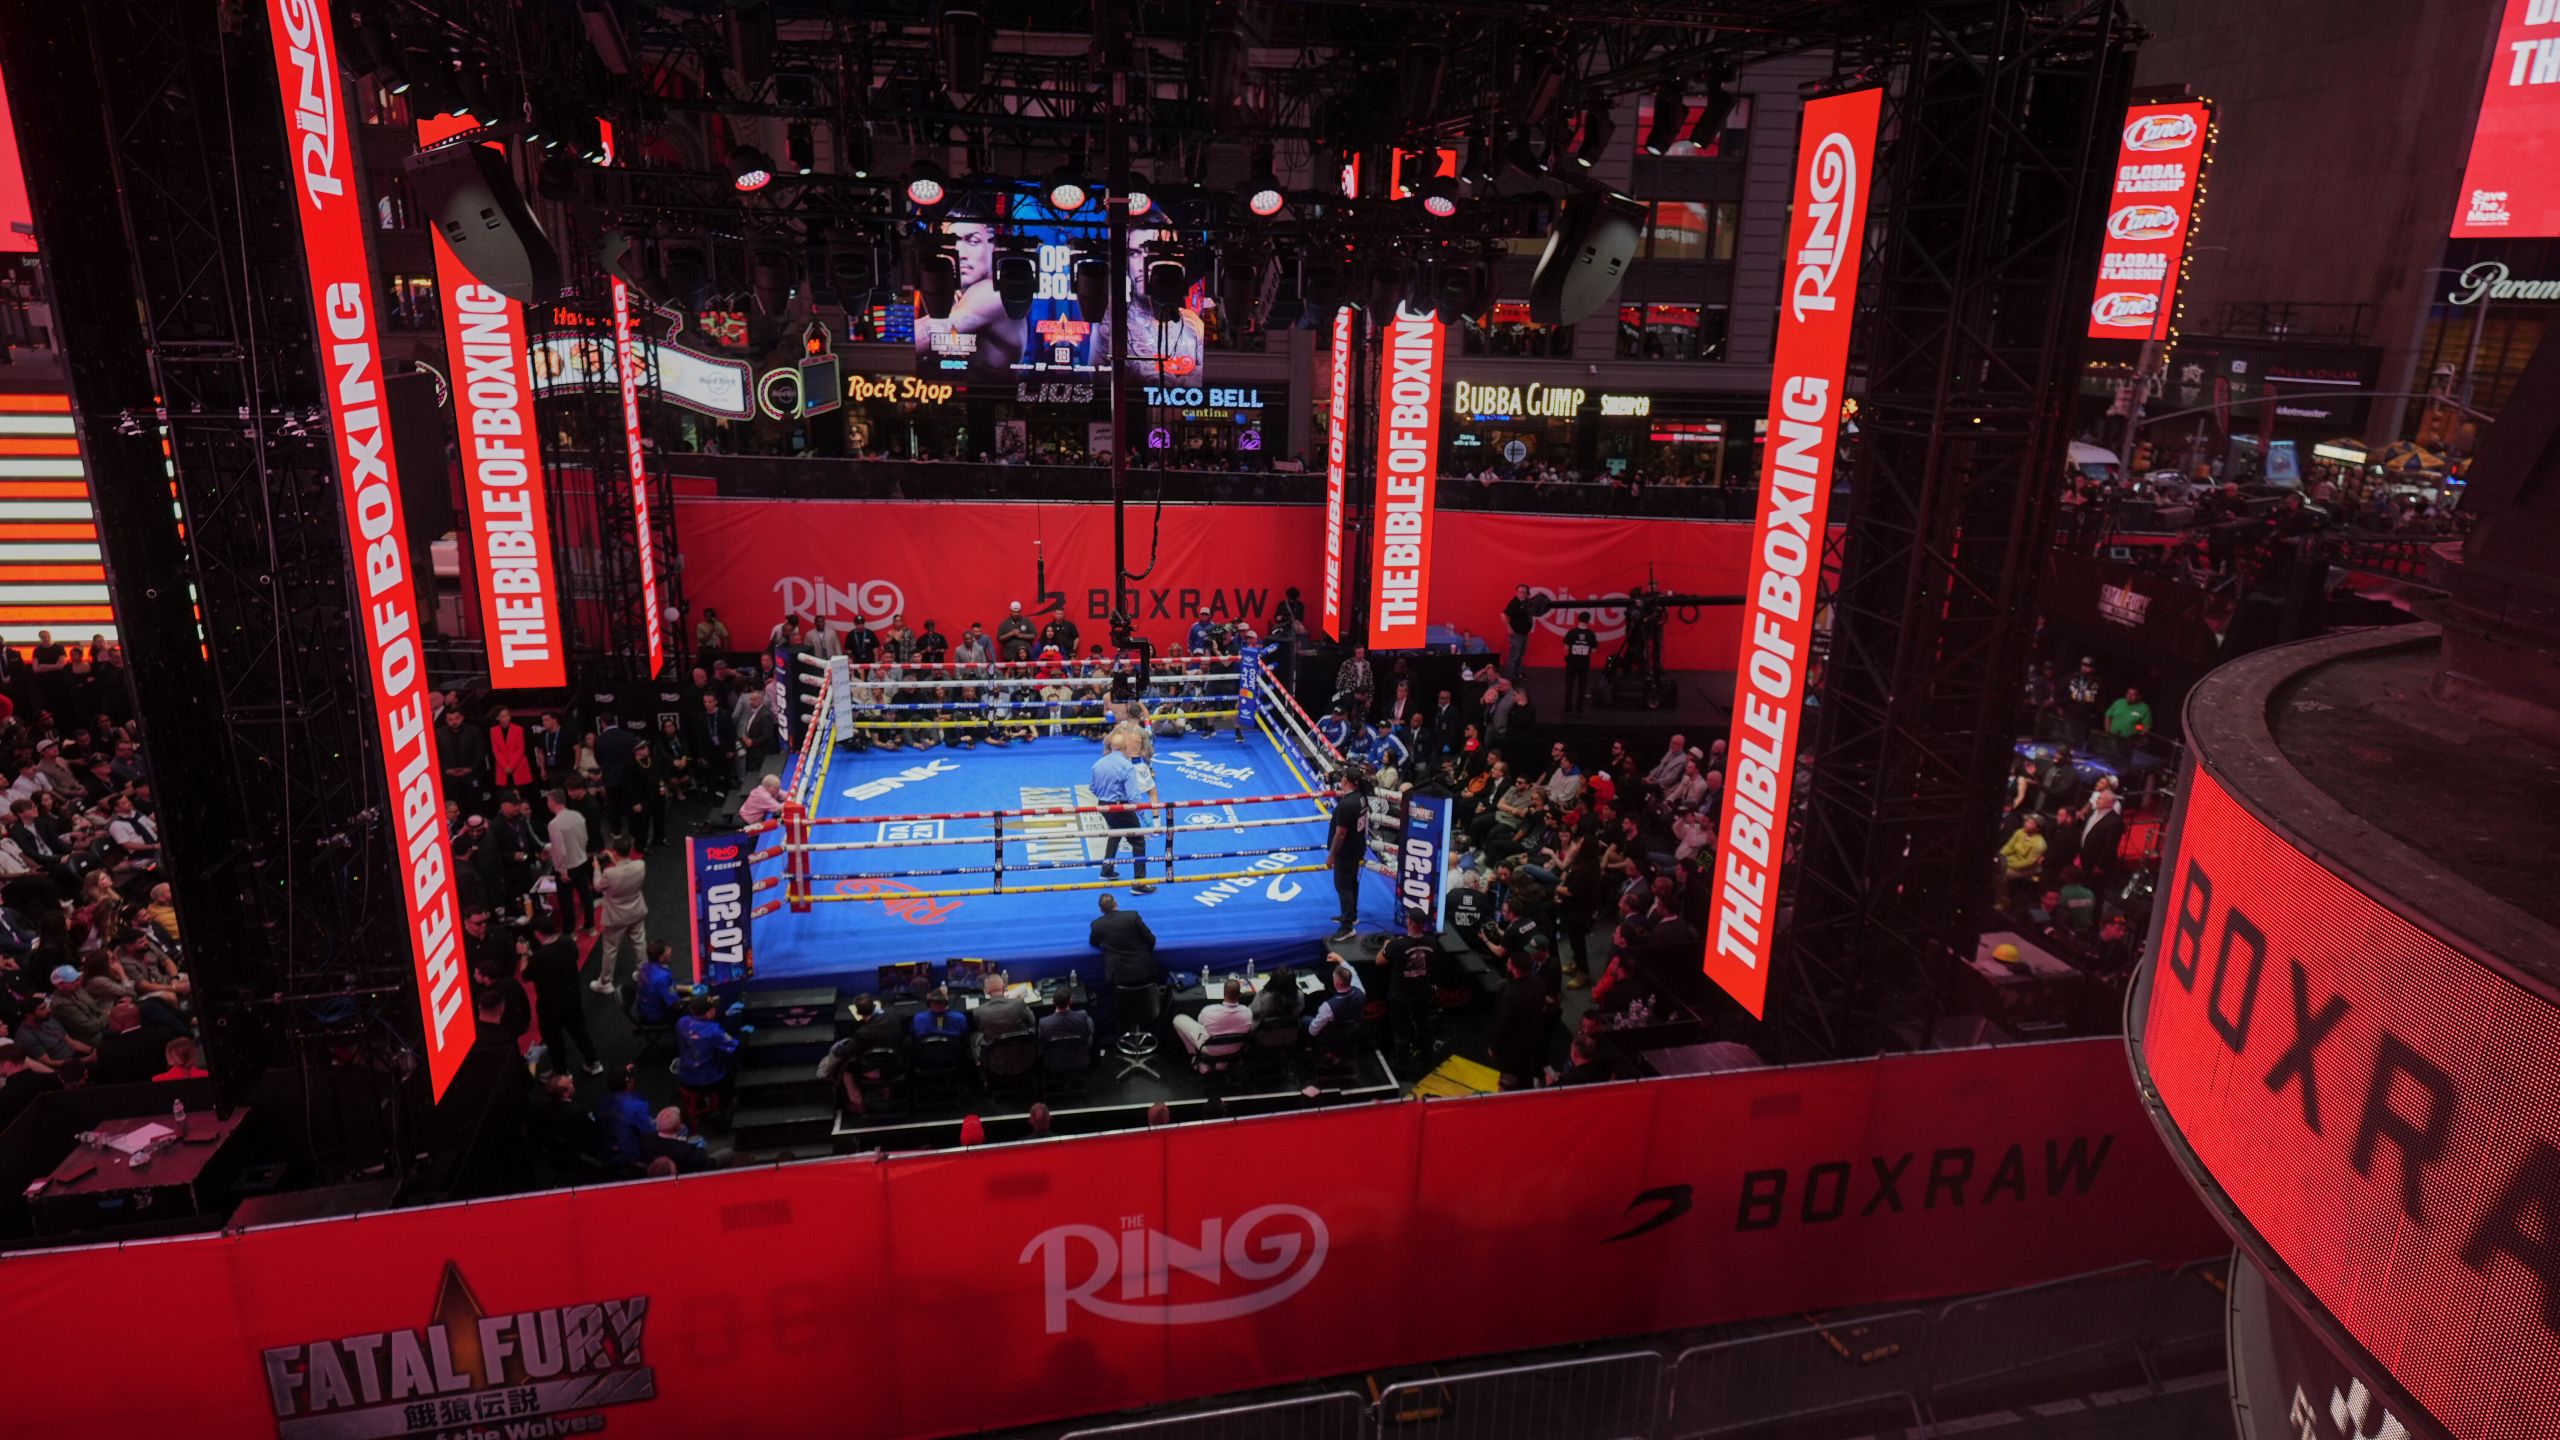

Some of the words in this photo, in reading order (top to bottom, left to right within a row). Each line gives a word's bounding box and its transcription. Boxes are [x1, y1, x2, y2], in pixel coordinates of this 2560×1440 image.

[280, 0, 343, 210] RING
[2116, 179, 2185, 193] FLAGSHIP
[2119, 164, 2185, 180] GLOBAL
[2471, 189, 2508, 202] Save
[1793, 133, 1856, 322] RING
[2467, 211, 2511, 222] Music
[2471, 201, 2498, 212] The
[2101, 267, 2166, 280] FLAGSHIP
[2104, 253, 2167, 269] GLOBAL
[456, 285, 521, 435] BOXING
[615, 284, 642, 430] BOXING
[848, 375, 897, 402] Rock
[901, 377, 953, 405] Shop
[1143, 386, 1204, 407] TACO
[1209, 388, 1264, 408] BELL
[1182, 408, 1228, 418] cantina
[1455, 381, 1522, 415] BUBBA
[1526, 382, 1585, 416] GUMP
[326, 283, 402, 597] BOXING
[475, 438, 527, 486] OF
[629, 434, 642, 478] OF
[1330, 420, 1343, 463] OF
[1388, 430, 1426, 472] OF
[1328, 464, 1343, 557] BIBLE
[1384, 476, 1424, 566] BIBLE
[1758, 376, 1829, 621] BOXING
[482, 490, 540, 593] BIBLE
[635, 481, 655, 584] BIBLE
[773, 576, 904, 632] RING
[1089, 588, 1268, 620] BOXRAW
[1326, 556, 1338, 615] THE
[1380, 570, 1419, 631] THE
[373, 602, 415, 696] OF
[496, 597, 549, 667] THE
[646, 583, 659, 656] THE
[1750, 613, 1795, 698] OF
[389, 691, 445, 911] BIBLE
[1730, 693, 1786, 867] BIBLE
[705, 845, 739, 861] RING
[713, 860, 742, 871] BOXRAW
[1403, 838, 1433, 915] 02:07
[708, 882, 744, 963] 02:07
[1717, 853, 1765, 969] THE
[421, 892, 462, 1051] THE
[1736, 1135, 2116, 1232] BOXRAW
[1119, 1214, 1145, 1230] THE
[1018, 1203, 1330, 1335] RING
[264, 1324, 471, 1417] FATAL
[478, 1295, 648, 1386] FURY
[403, 1387, 541, 1431] 餓狼伝説
[504, 1412, 604, 1438] Wolves
